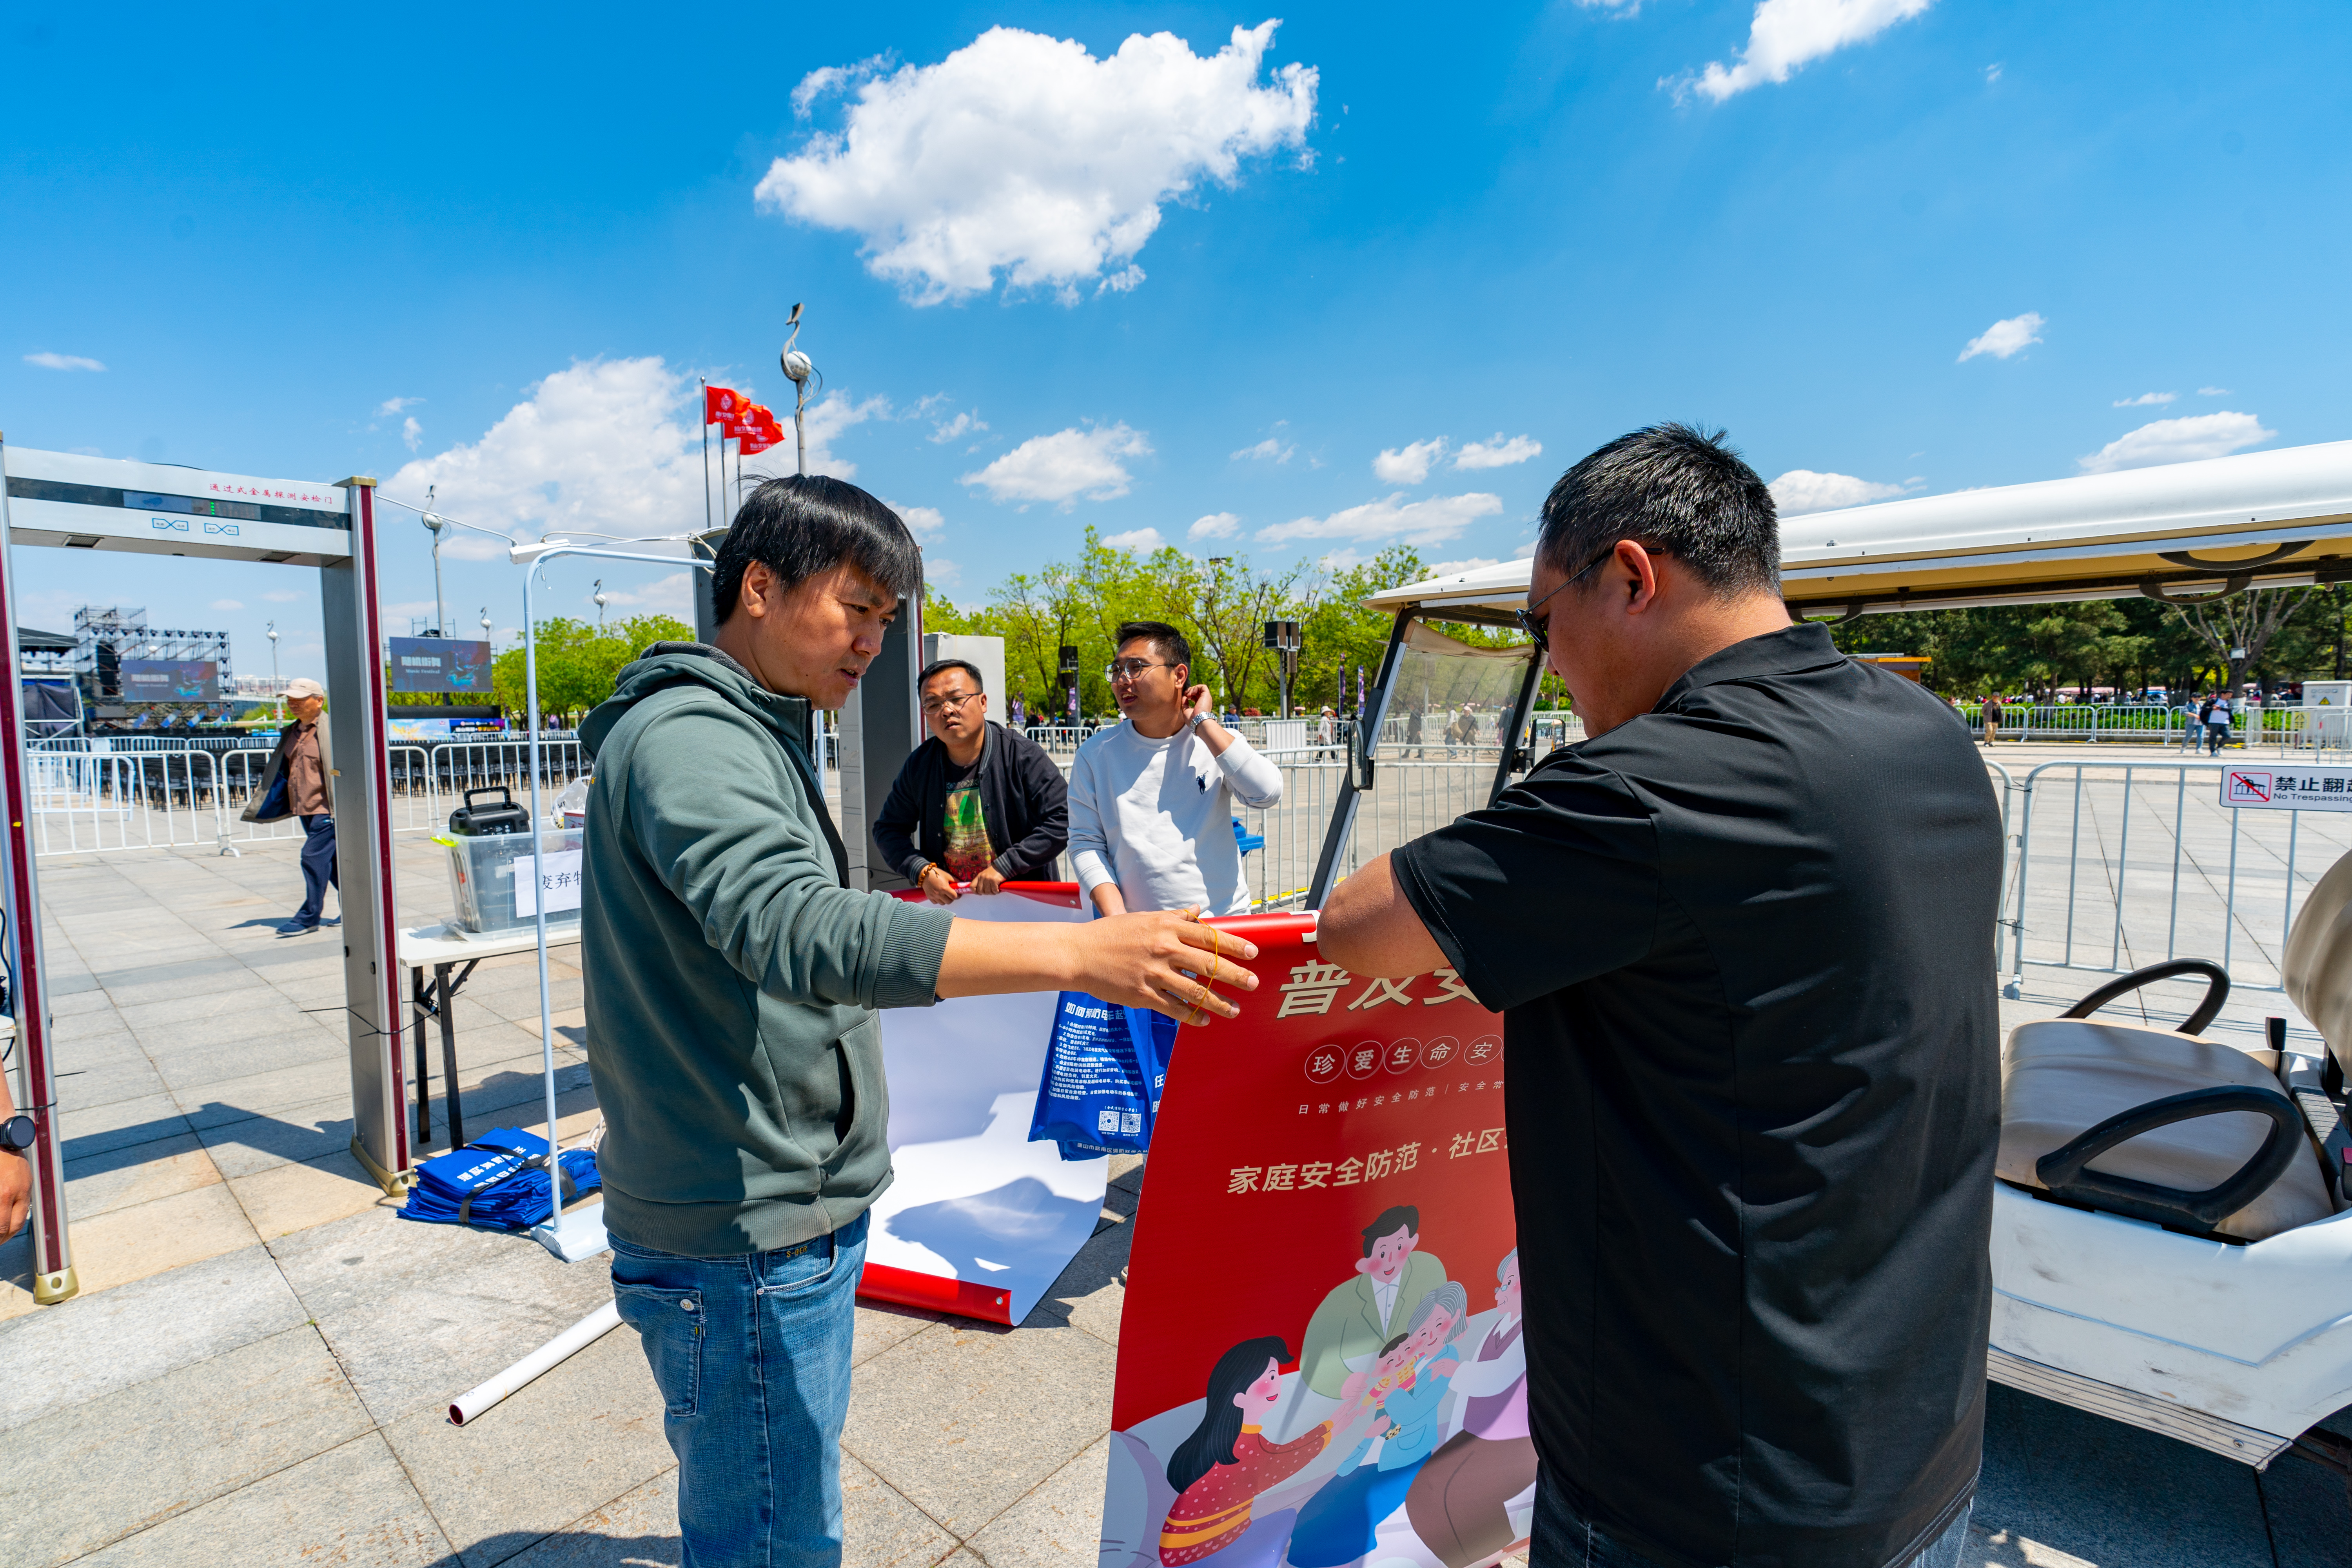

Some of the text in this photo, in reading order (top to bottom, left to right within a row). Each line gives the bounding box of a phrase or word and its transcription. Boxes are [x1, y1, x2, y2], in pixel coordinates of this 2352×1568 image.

[210, 483, 332, 504] 通过式金属探测安检门
[1154, 1074, 1164, 1088] 任
[1227, 1127, 1508, 1194] 家庭安全防范·社区
